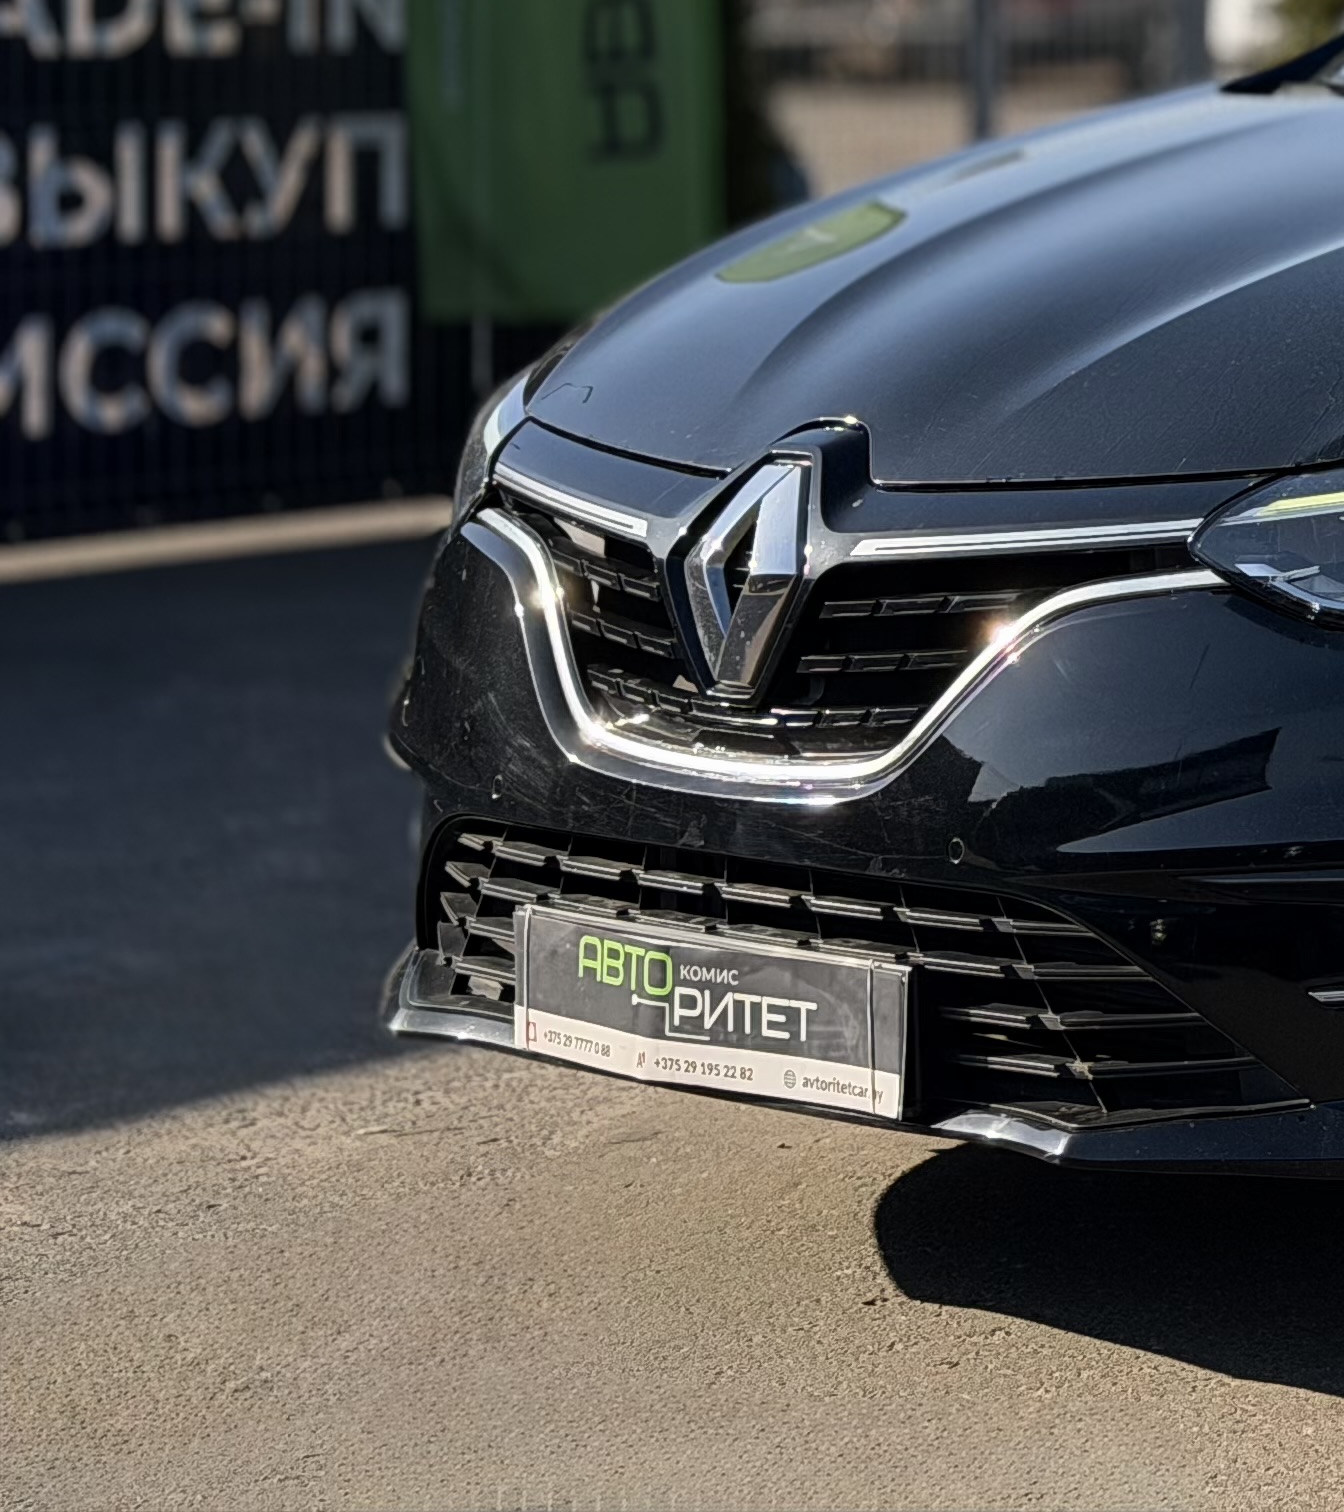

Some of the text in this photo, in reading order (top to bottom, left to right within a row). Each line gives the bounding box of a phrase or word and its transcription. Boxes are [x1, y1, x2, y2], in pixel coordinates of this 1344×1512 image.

[578, 935, 673, 996] АВТО
[679, 964, 740, 986] КОМИС
[674, 986, 818, 1042] РИТЕТ
[654, 1057, 754, 1081] +375 29 195 22 82
[802, 1075, 884, 1104] avtoritetcar.y
